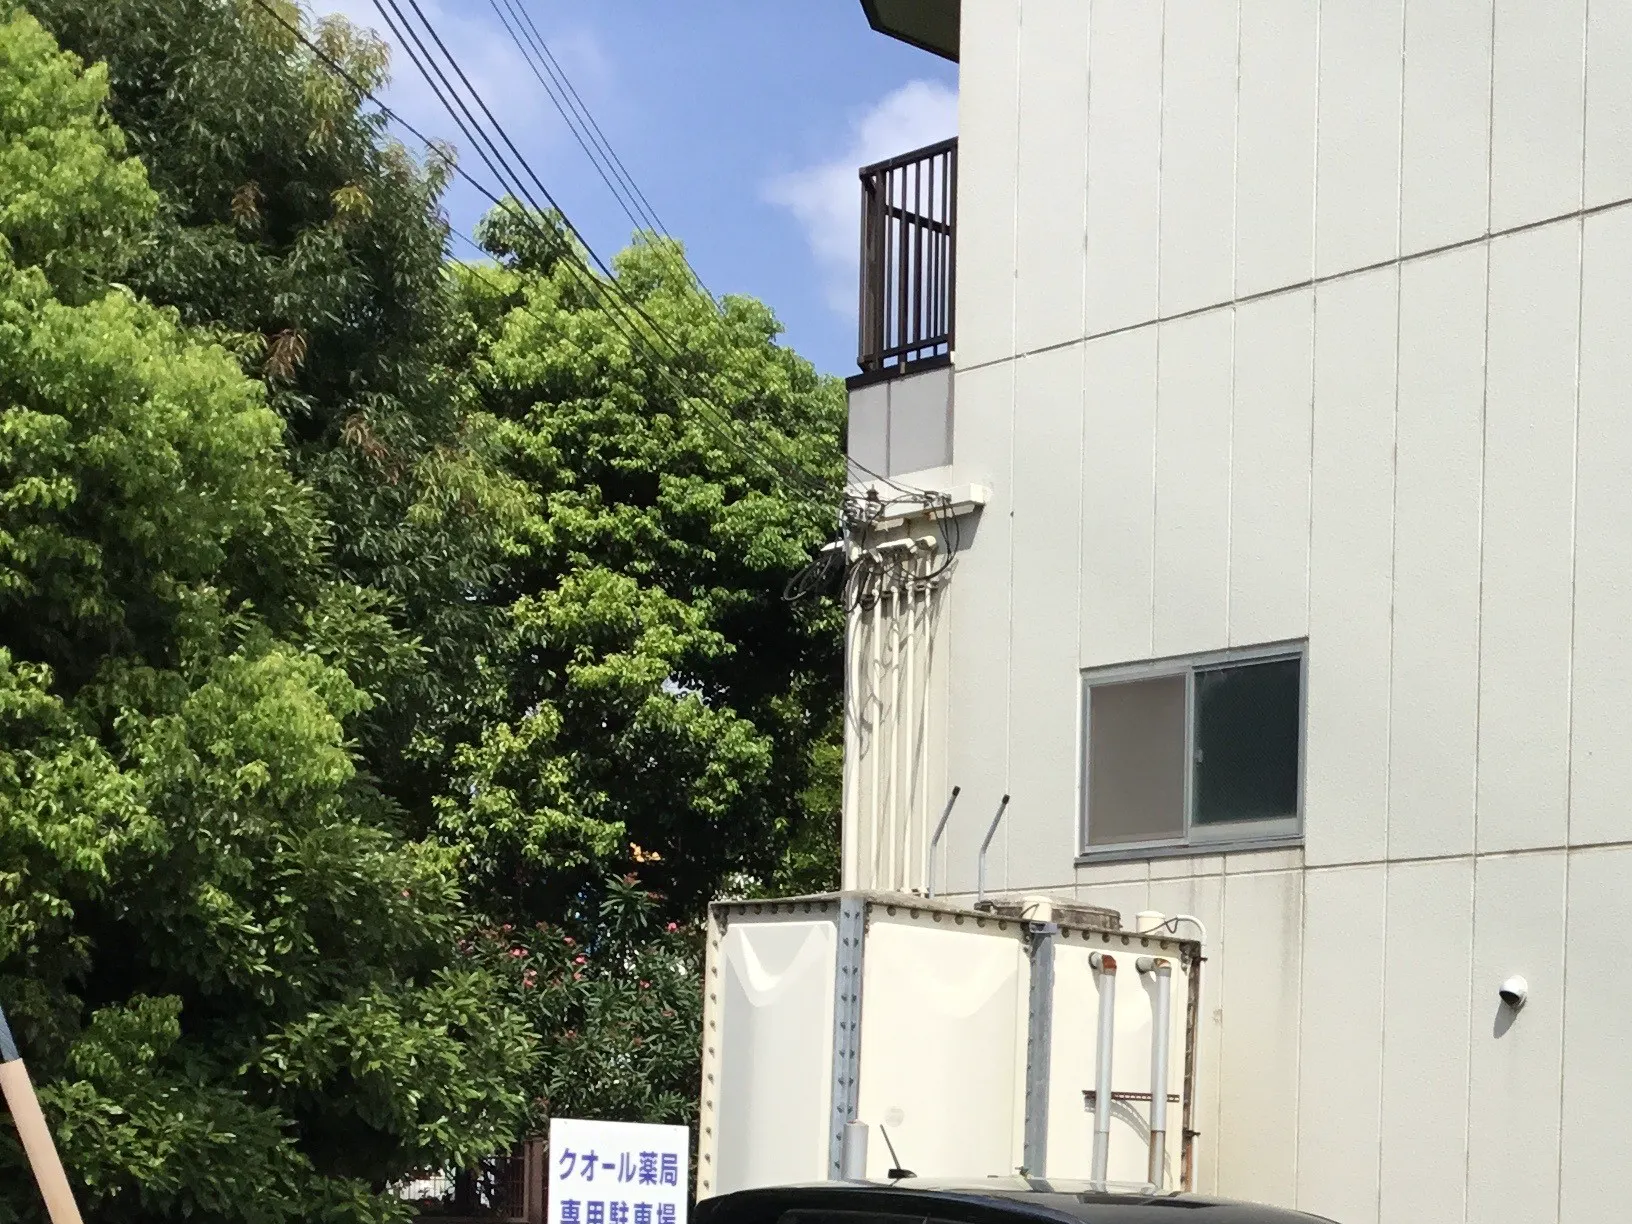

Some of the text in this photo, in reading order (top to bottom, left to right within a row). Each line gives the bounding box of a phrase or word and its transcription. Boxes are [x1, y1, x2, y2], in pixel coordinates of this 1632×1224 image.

[558, 1147, 679, 1188] クオール薬局
